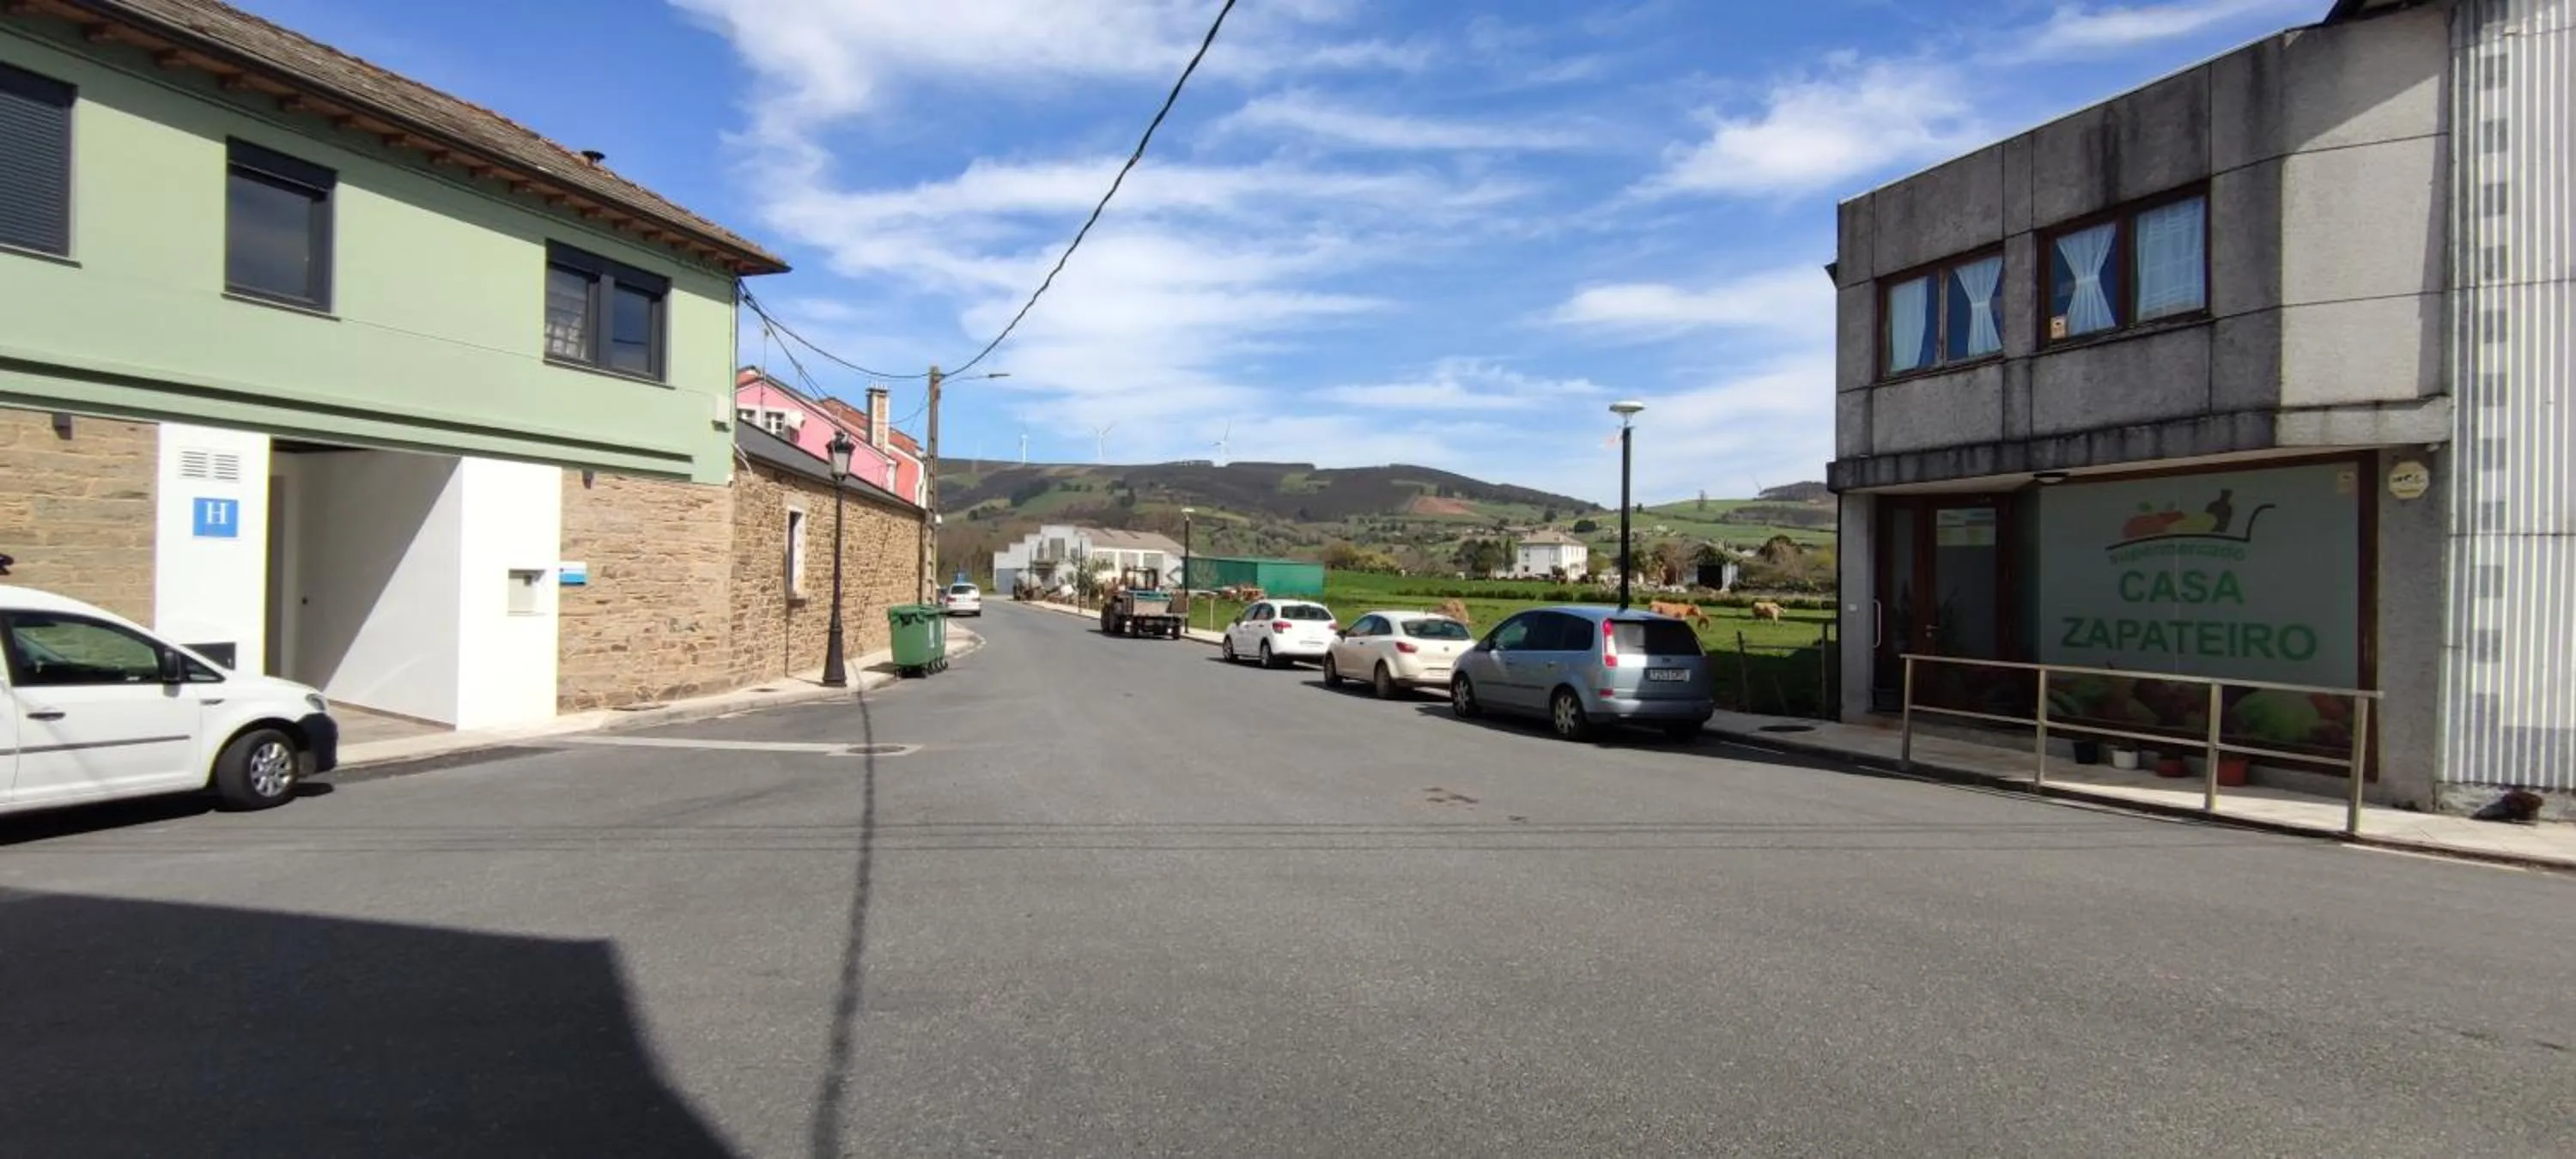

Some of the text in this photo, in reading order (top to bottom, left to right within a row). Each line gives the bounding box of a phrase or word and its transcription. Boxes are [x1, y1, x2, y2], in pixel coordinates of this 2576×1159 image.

[206, 501, 228, 524] H
[2118, 570, 2245, 604] CASA
[2062, 616, 2318, 661] ZAPATEIRO
